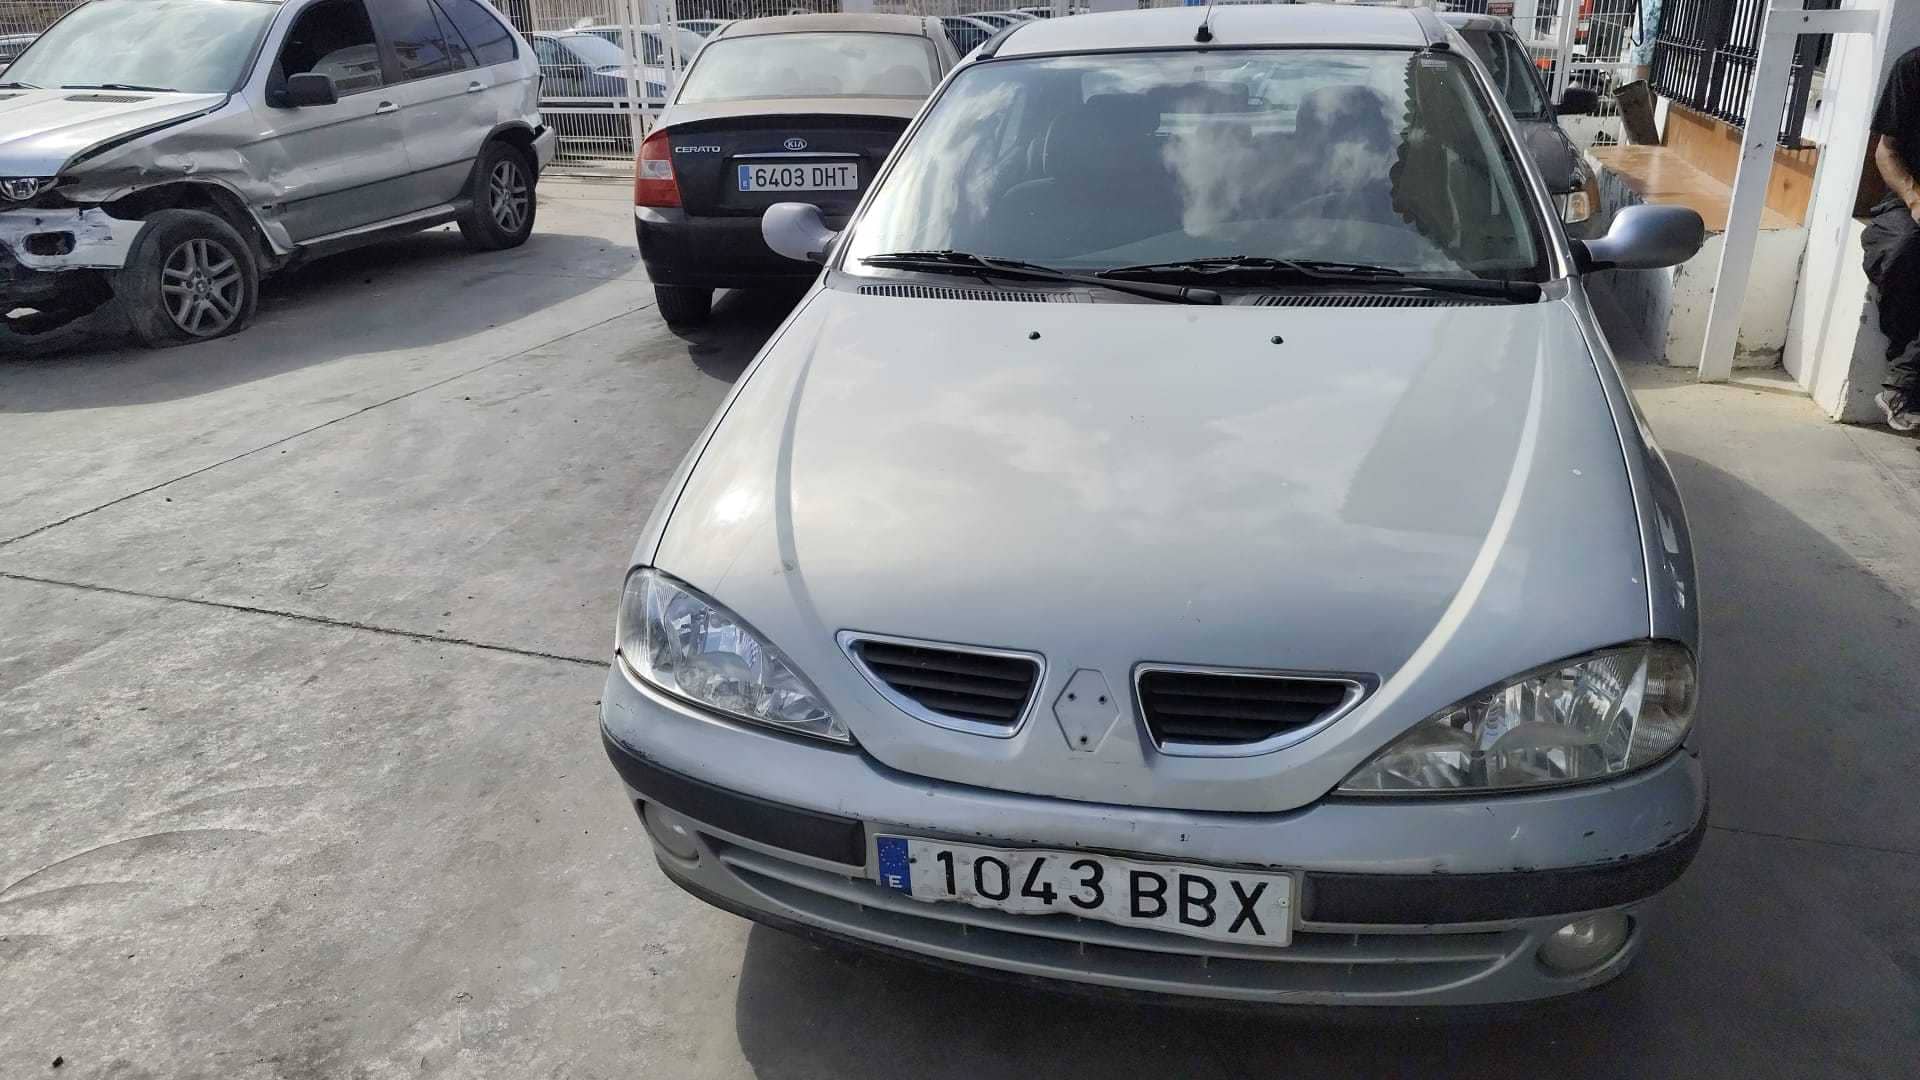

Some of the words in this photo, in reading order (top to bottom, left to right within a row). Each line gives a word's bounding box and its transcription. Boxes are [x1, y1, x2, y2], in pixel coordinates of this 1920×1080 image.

[675, 146, 721, 154] CERATO
[755, 168, 805, 188] 6403
[812, 167, 849, 187] DHT
[889, 874, 903, 888] E
[937, 850, 1105, 909] 1043
[1129, 870, 1269, 936] BBX
